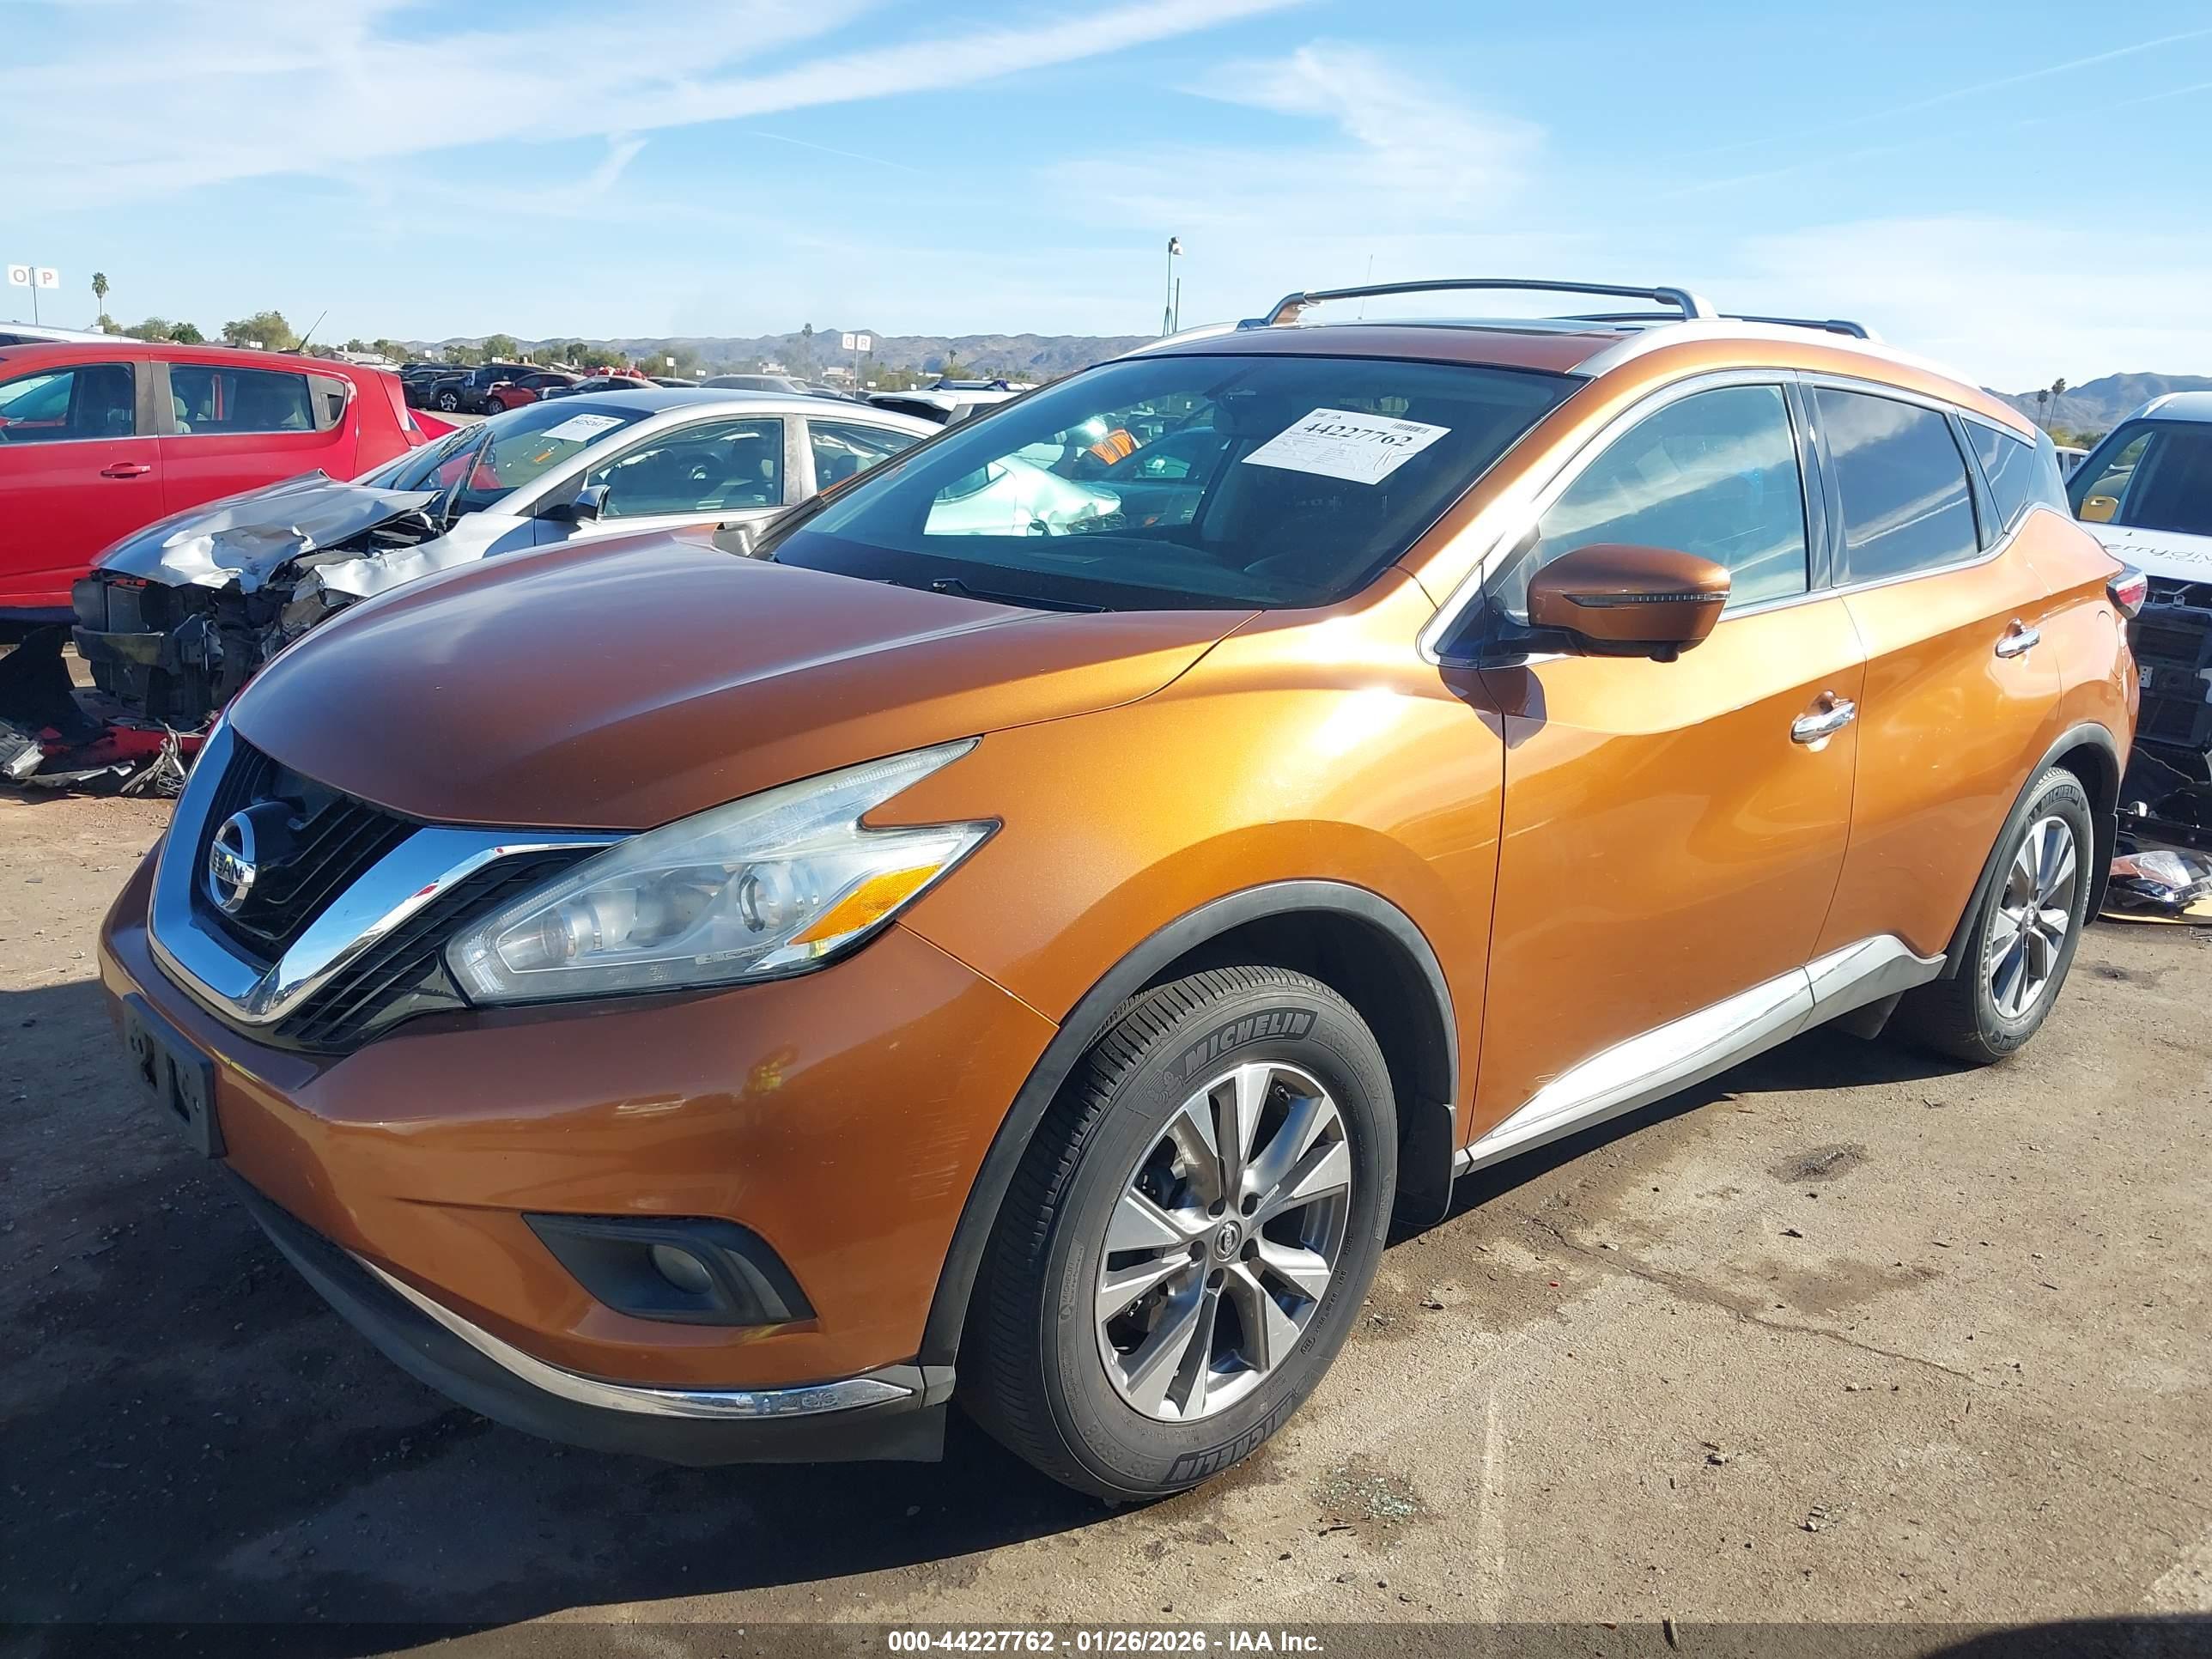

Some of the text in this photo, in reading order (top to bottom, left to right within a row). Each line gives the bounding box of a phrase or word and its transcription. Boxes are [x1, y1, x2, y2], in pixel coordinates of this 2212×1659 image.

[13, 270, 27, 283] O
[42, 272, 52, 284] P
[1303, 422, 1413, 447] 44227762
[1184, 1012, 1311, 1076] MICHELIN
[1169, 1395, 1293, 1482] MICHELIN
